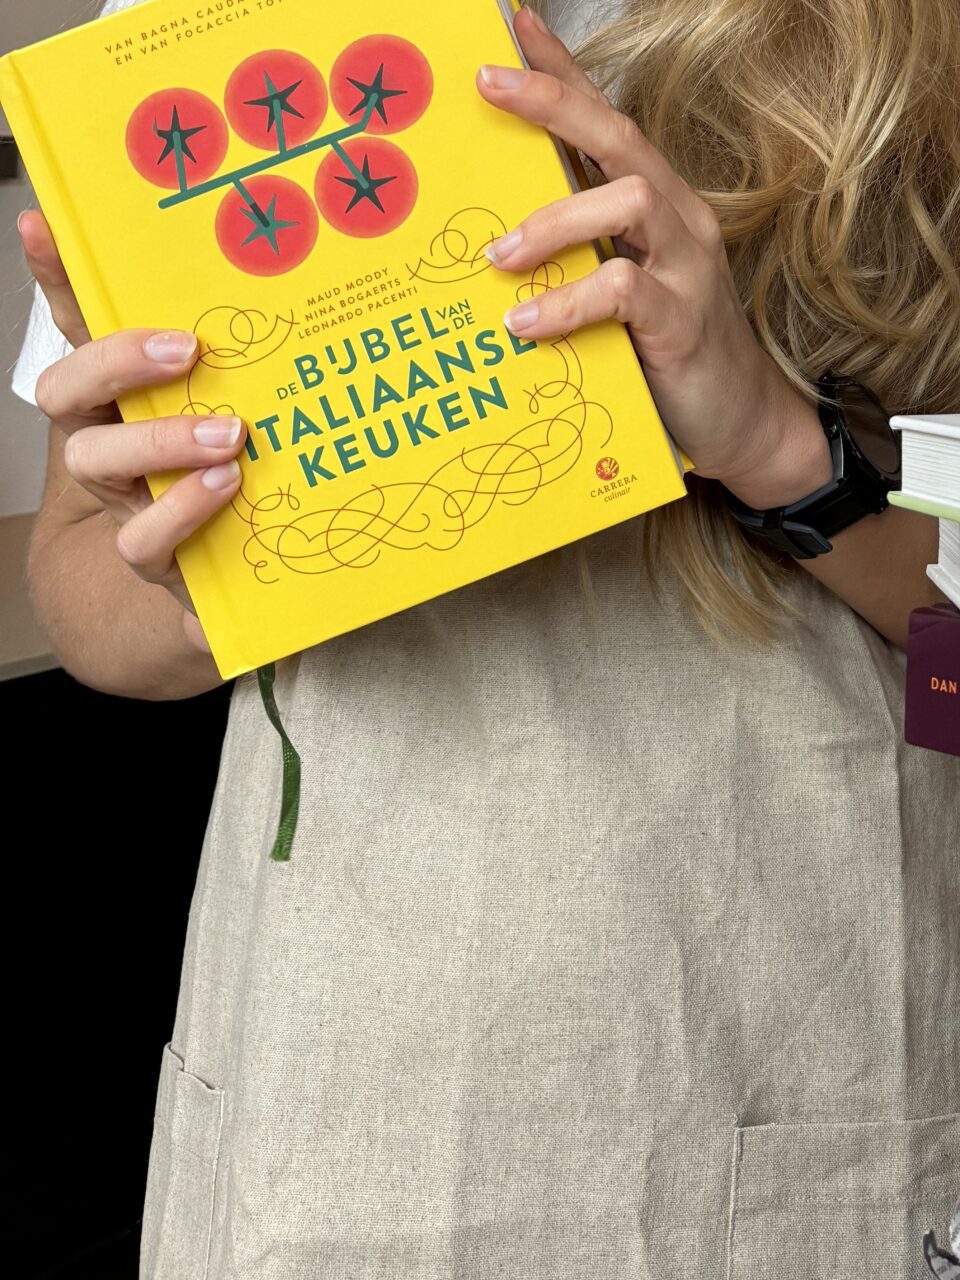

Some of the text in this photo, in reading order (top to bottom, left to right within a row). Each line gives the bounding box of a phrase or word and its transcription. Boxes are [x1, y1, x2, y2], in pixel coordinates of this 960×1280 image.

[104, 37, 133, 55] VAN
[141, 16, 189, 41] BAGNA
[115, 51, 133, 66] EN
[140, 39, 169, 56] VAN
[176, 7, 251, 43] FOCACCIA
[304, 277, 402, 322] NINA BOGAERTS
[307, 267, 390, 306] MAUD MOODY
[298, 286, 419, 340] LEONARDO PACENTI
[276, 298, 476, 401] DE BIJBEL VAN DE
[298, 375, 509, 488] KEUKEN
[590, 474, 639, 498] CARRERA
[603, 486, 632, 503] culinair
[931, 676, 958, 695] DAN
